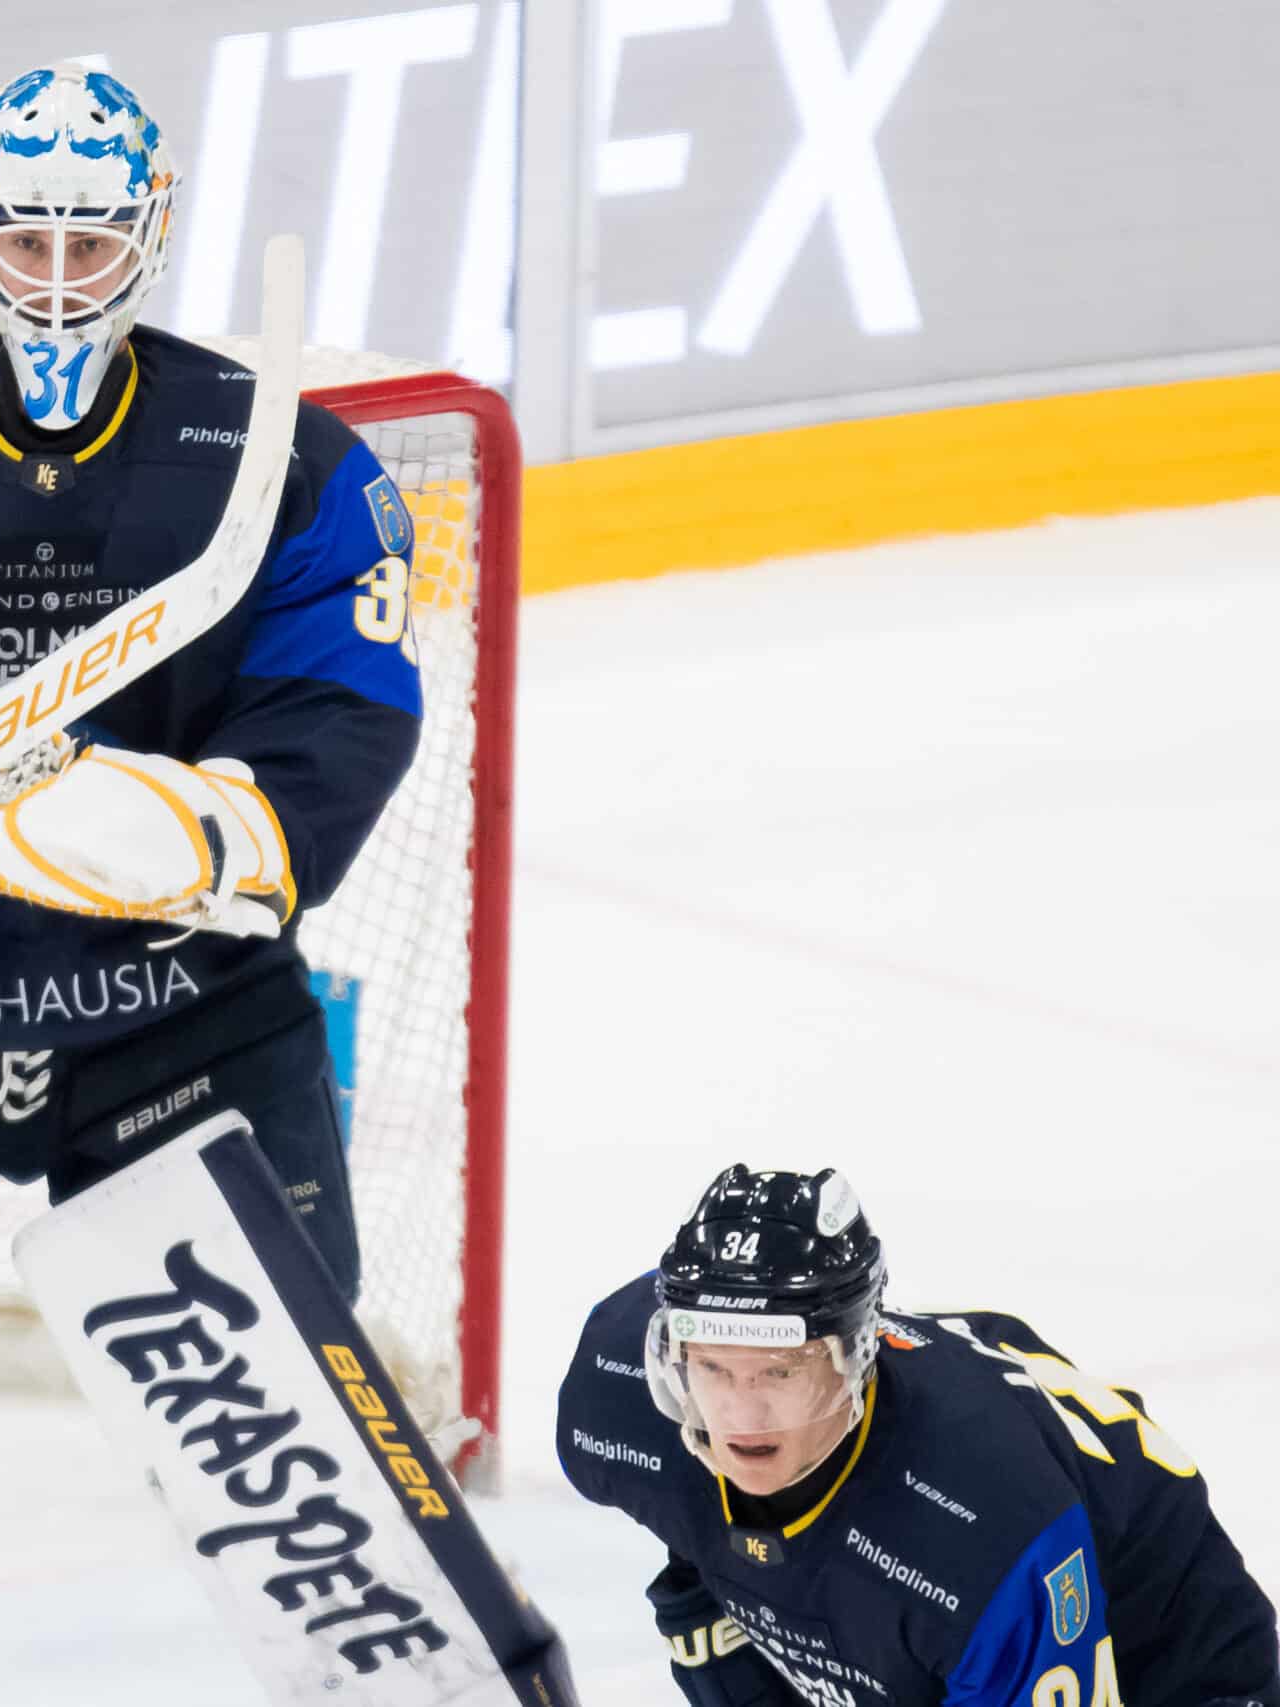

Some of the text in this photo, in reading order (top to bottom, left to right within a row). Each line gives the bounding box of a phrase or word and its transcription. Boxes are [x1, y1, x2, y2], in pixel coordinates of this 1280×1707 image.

[22, 340, 95, 421] 31
[353, 556, 419, 667] 3
[719, 1231, 761, 1261] 34
[701, 1318, 801, 1338] PILKINGTON
[846, 1527, 960, 1613] Pihlajalinna
[726, 1599, 827, 1650] TITANIUM
